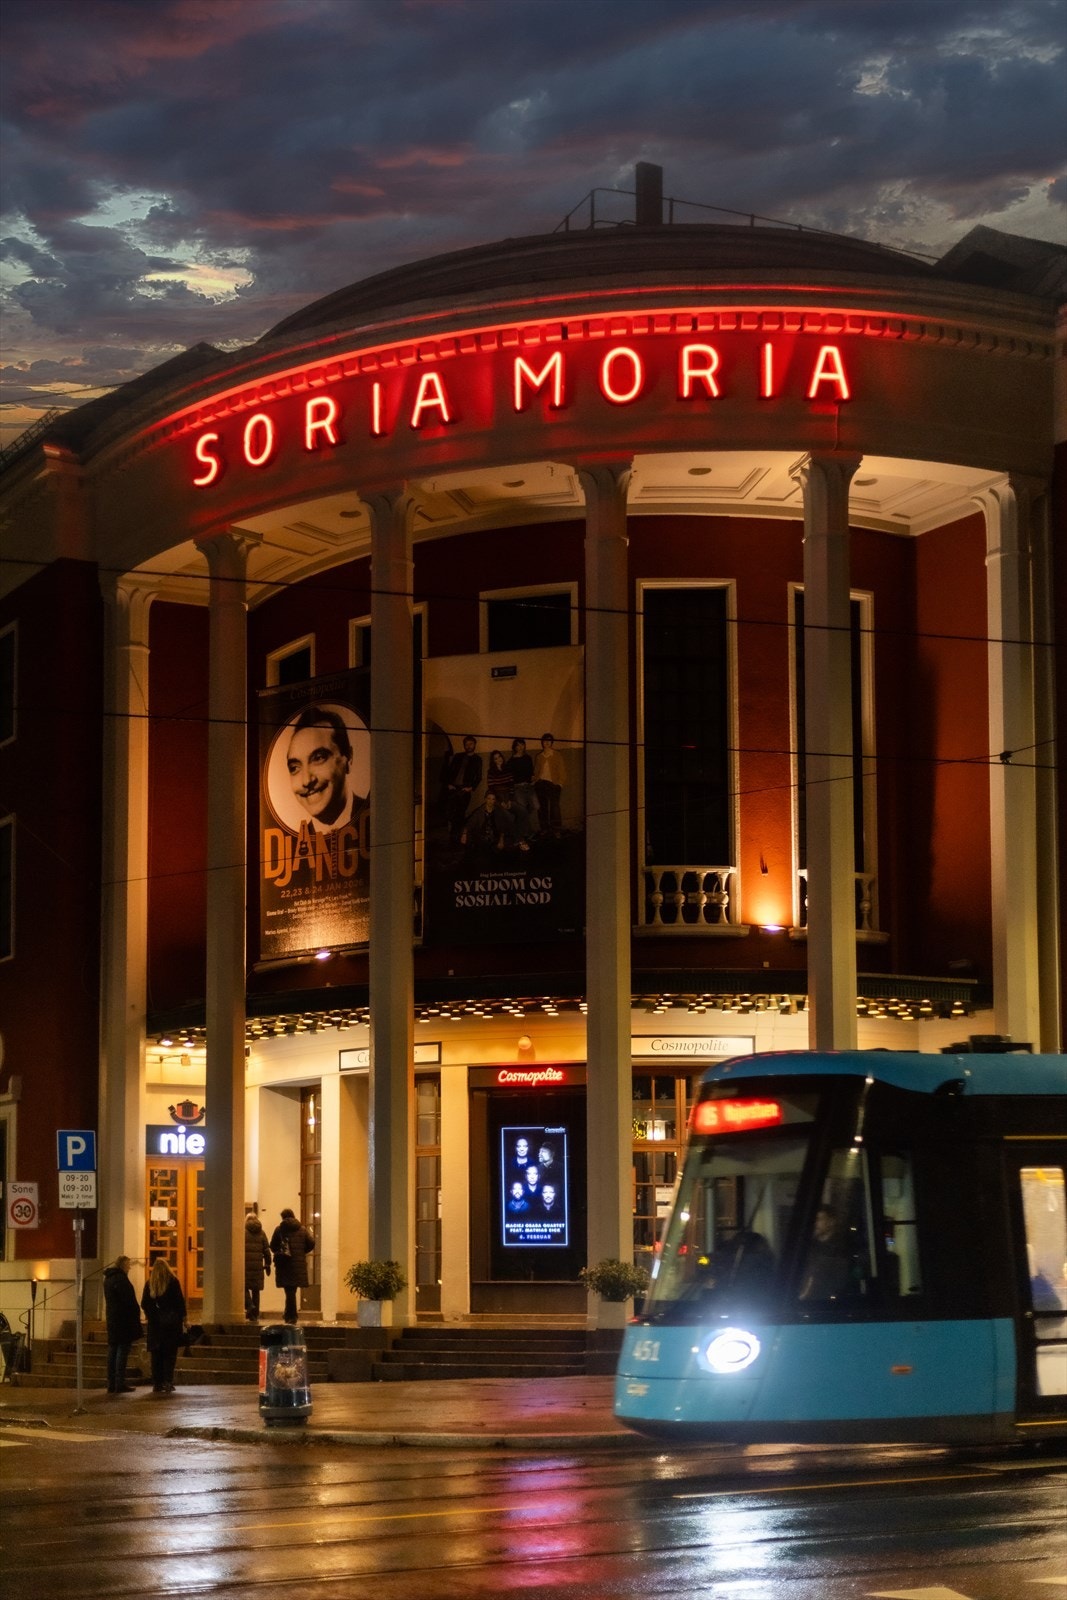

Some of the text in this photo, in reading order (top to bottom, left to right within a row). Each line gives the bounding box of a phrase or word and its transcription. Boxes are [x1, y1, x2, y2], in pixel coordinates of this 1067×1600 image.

[192, 341, 851, 487] SORIA MORIA
[454, 876, 553, 893] SYKDOM OG
[455, 893, 512, 908] SOSIAL
[651, 1038, 729, 1055] Cosmopolite
[498, 1068, 563, 1086] Cosmopolite
[66, 1136, 87, 1167] P
[12, 1184, 34, 1194] Sone
[15, 1204, 32, 1218] 30
